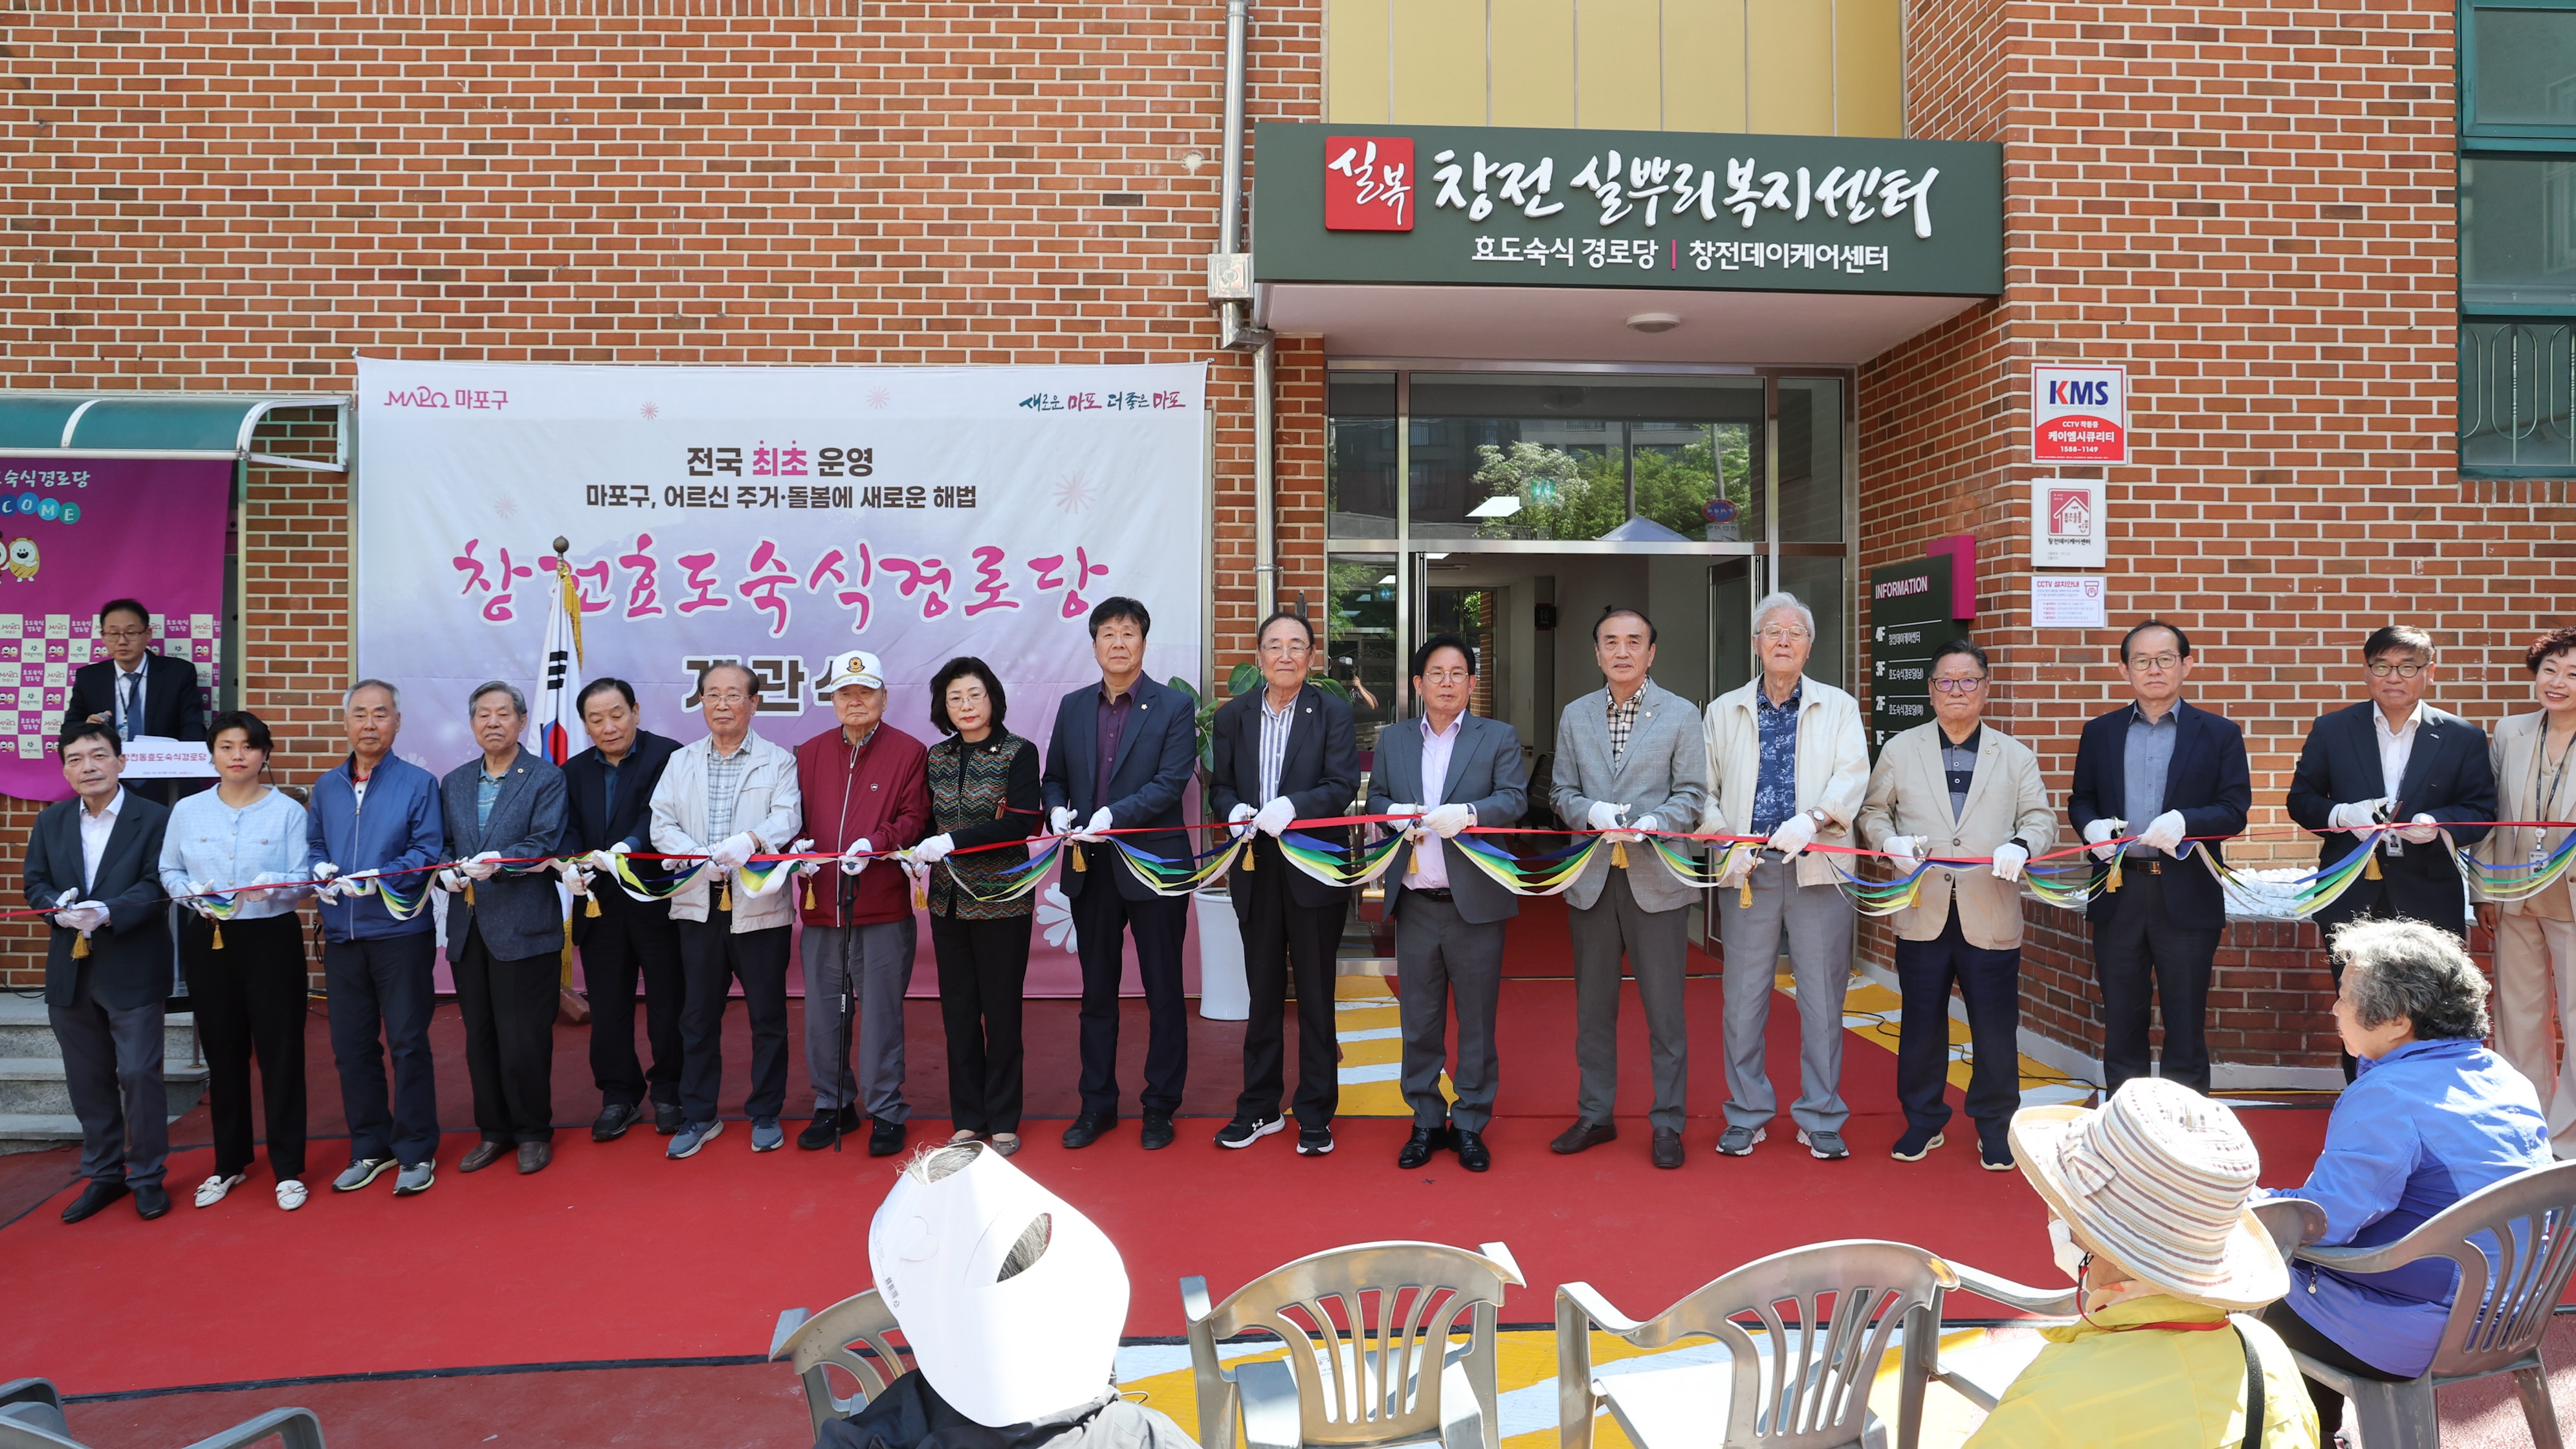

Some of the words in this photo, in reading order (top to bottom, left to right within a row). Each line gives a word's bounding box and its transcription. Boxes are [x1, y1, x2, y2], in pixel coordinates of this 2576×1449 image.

[1433, 149, 1565, 222] 창전
[1471, 235, 1574, 267] 효도숙식
[1581, 239, 1659, 269] 경로당
[1688, 239, 1889, 274] 창전데이케어센터
[456, 389, 509, 409] 마포구
[1018, 392, 1064, 412] 새로운
[1068, 392, 1102, 412] 마포
[1107, 391, 1123, 411] 더
[1153, 390, 1186, 410] 마포
[2050, 380, 2109, 406] KMS
[2048, 430, 2115, 443] 케이엠시큐리티
[687, 447, 743, 477] 전국
[753, 446, 808, 477] 최초
[818, 447, 874, 477] 운영
[0, 469, 91, 488] 숙식경로당
[586, 485, 656, 508] 마포구,
[664, 485, 729, 508] 어르신
[736, 486, 853, 509] 주거·돌봄에
[861, 486, 927, 509] 새로운
[933, 486, 976, 508] 해법
[1875, 576, 1928, 600] INFORMATION
[1875, 626, 1886, 642] 4F
[1876, 661, 1886, 677] 3F
[1876, 695, 1886, 711] 2F
